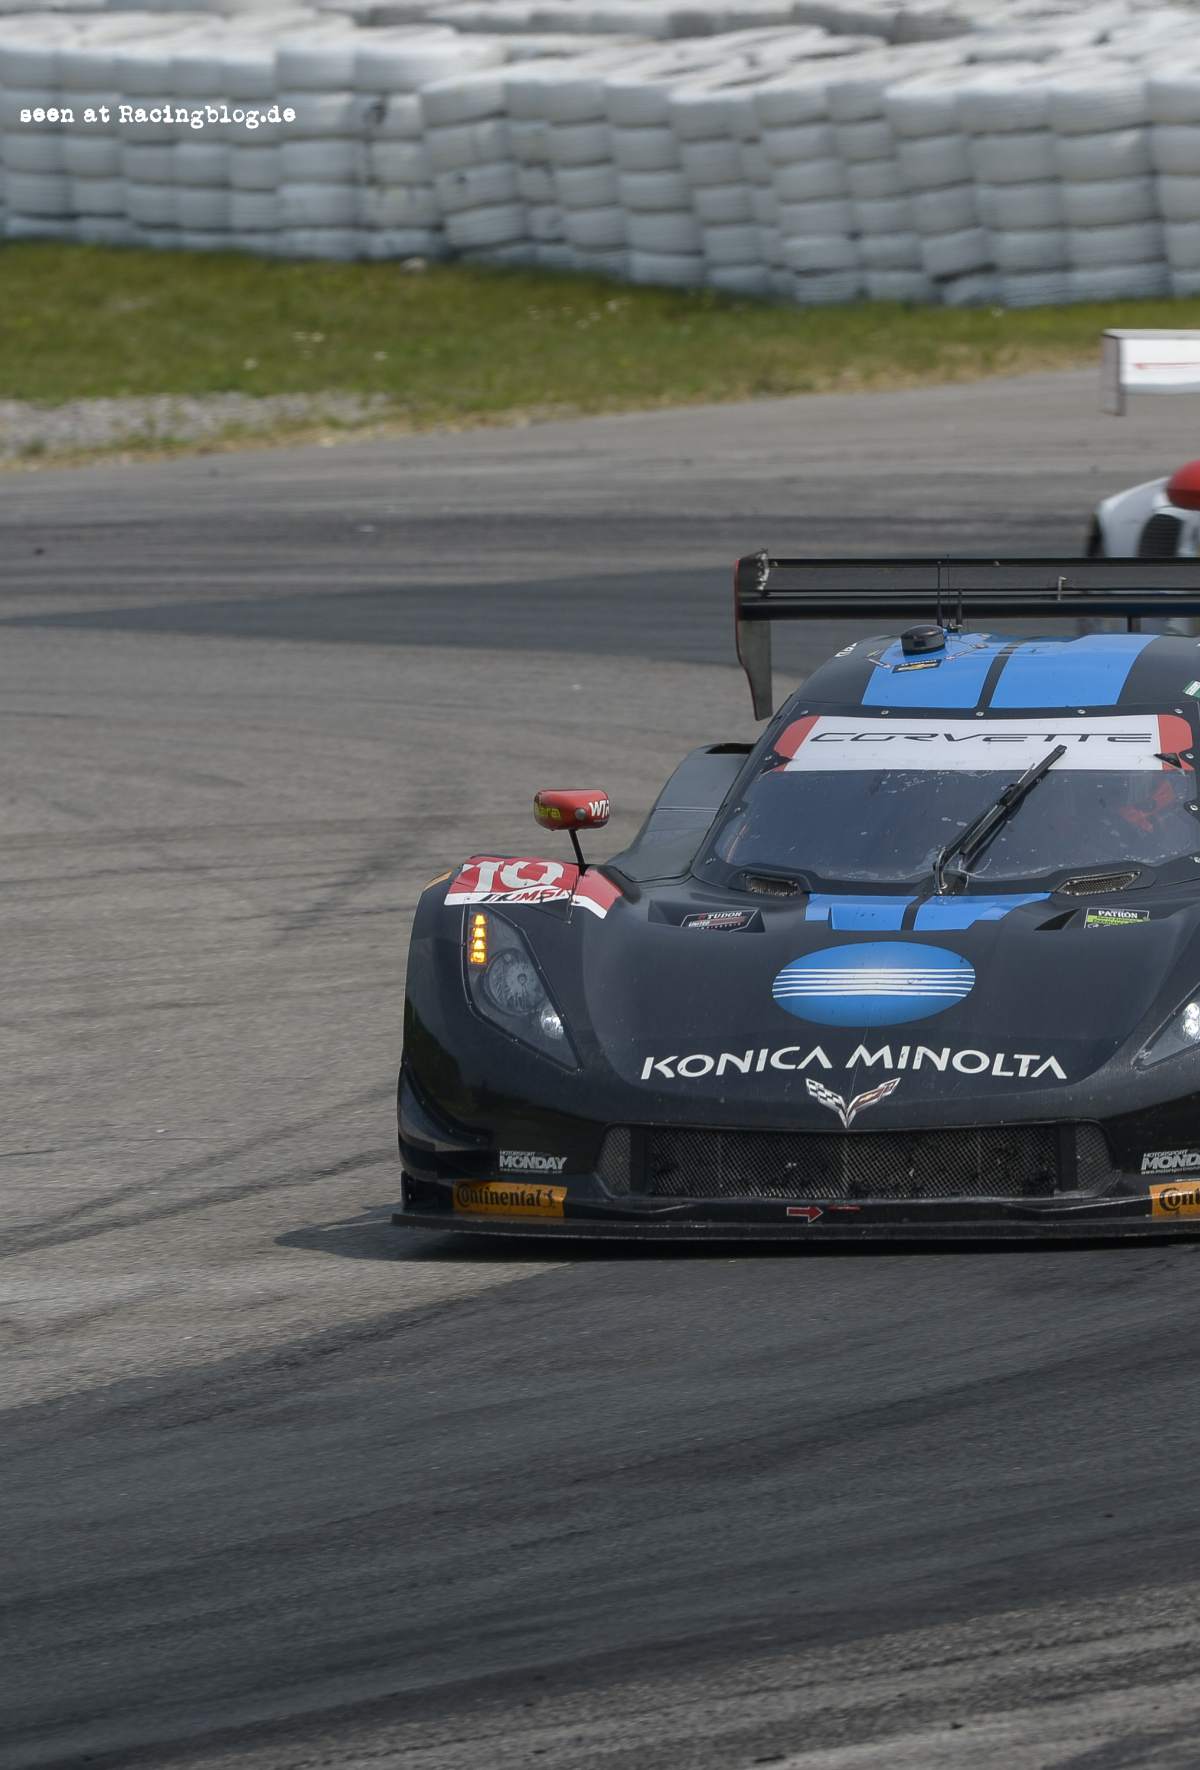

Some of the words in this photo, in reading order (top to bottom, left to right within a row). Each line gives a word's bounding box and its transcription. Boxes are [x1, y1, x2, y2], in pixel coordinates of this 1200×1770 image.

[810, 732, 1153, 743] CORVETTE
[462, 860, 565, 893] 10
[640, 1046, 833, 1080] KONICA
[845, 1044, 1068, 1080] MINOLTA
[499, 1156, 568, 1170] MONDAY
[457, 1184, 542, 1207] Continental
